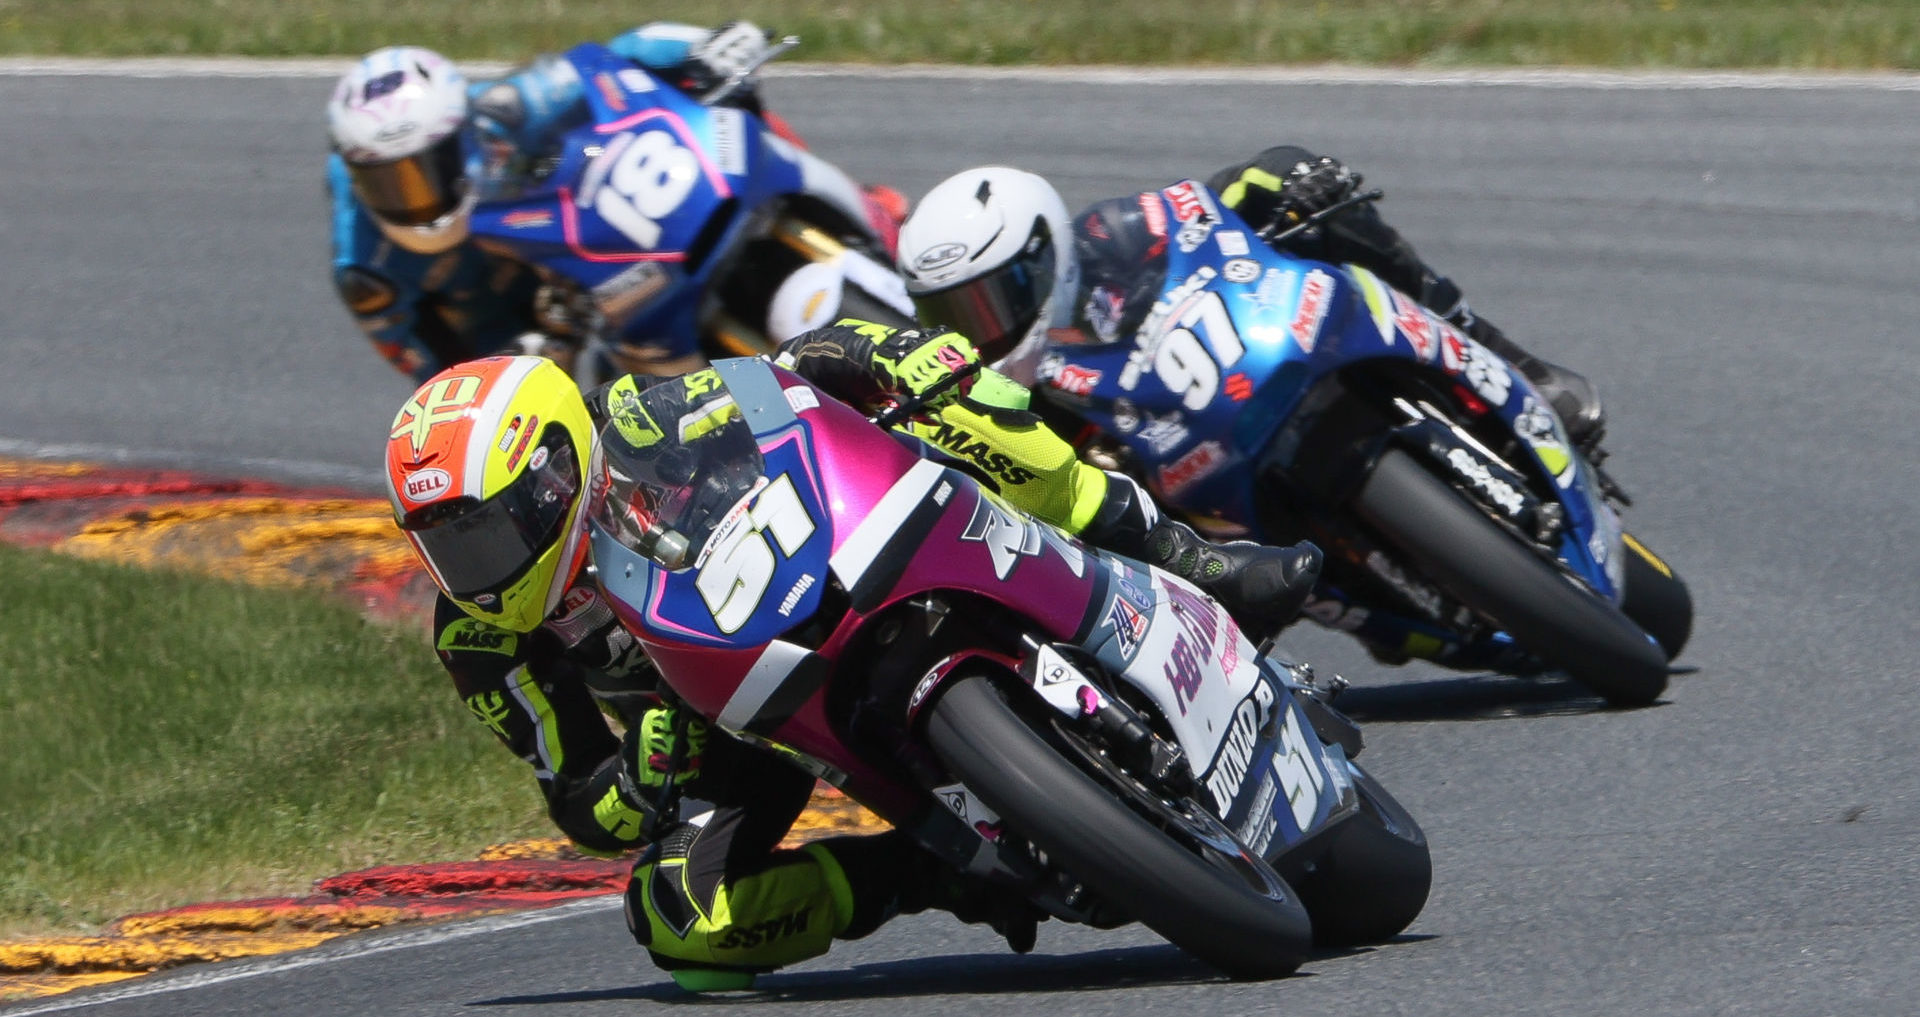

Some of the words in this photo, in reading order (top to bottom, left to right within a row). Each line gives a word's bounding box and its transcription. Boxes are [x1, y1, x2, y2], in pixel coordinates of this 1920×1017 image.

[595, 130, 700, 250] 18
[1155, 289, 1247, 411] 97
[408, 476, 444, 495] BELL
[532, 450, 547, 467] BELL
[930, 424, 1042, 486] MASS
[695, 471, 817, 635] 51
[556, 589, 594, 615] ELL
[778, 573, 815, 618] YAMAHA
[1206, 680, 1274, 820] DUNLOP
[1272, 704, 1324, 832] 51
[720, 909, 809, 949] MASS
